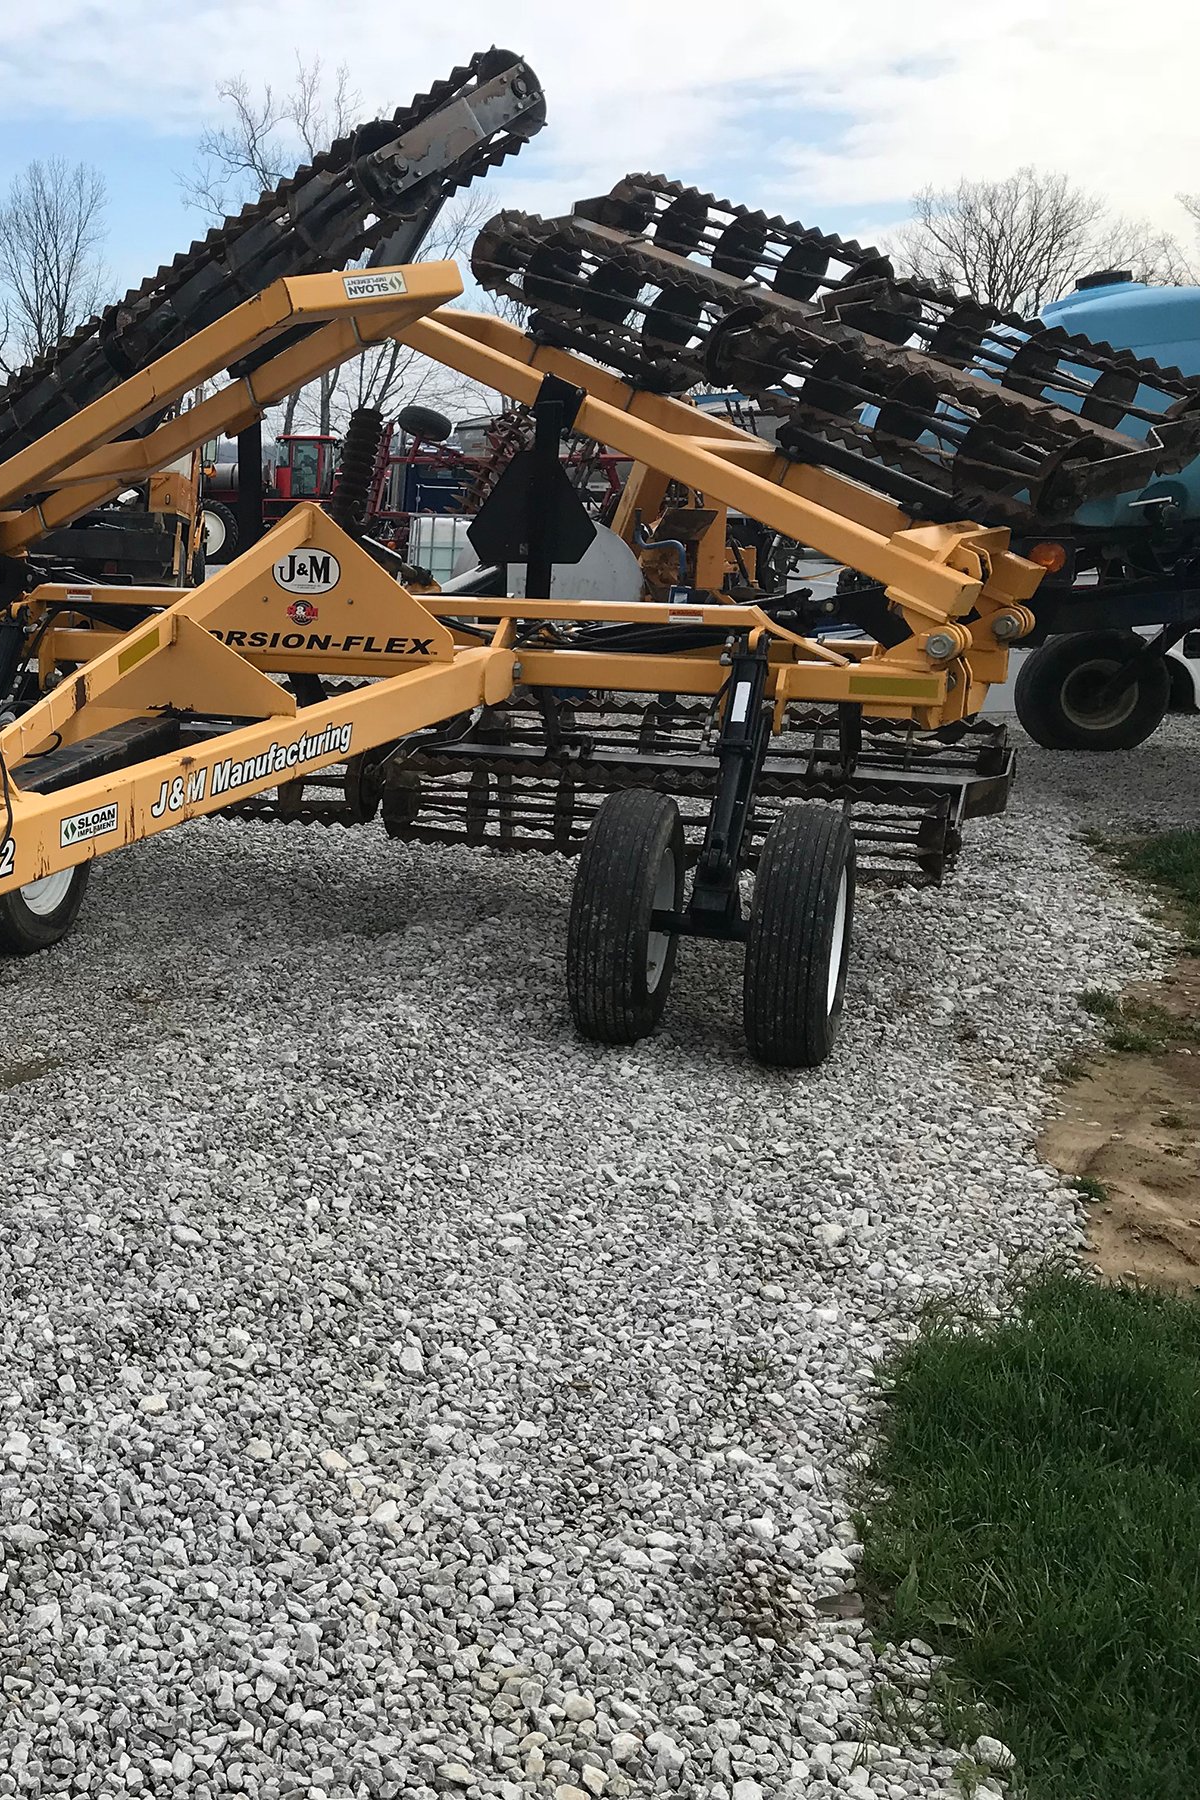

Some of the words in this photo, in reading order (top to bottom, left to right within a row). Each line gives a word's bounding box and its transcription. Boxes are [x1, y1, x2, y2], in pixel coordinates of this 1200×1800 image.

[347, 276, 387, 286] IMPLEMENT
[348, 283, 389, 295] SLOAN
[278, 555, 331, 584] J&M
[208, 630, 435, 655] RSION-FLEX
[151, 767, 207, 818] J&M
[210, 721, 353, 797] Manufacturing
[77, 808, 116, 830] SLOAN
